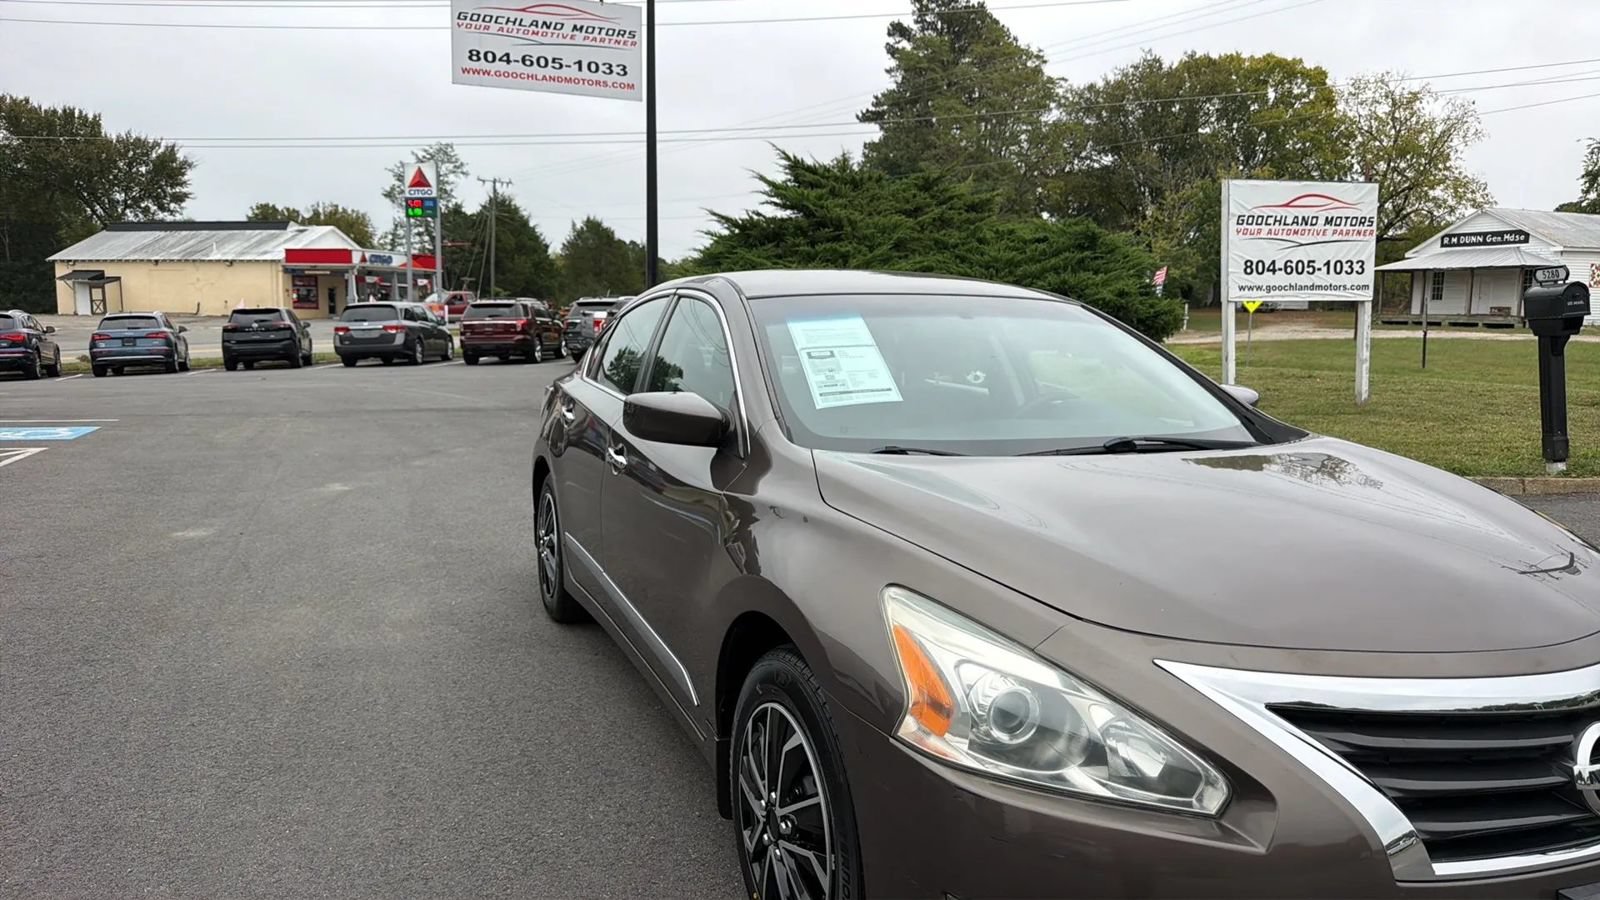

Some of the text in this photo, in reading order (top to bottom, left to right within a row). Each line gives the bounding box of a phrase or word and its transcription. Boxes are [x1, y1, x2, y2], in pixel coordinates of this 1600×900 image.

[456, 11, 637, 40] GOOCHLAND MOTORS
[456, 22, 638, 48] YOUR AUTOMOTIVE PARTNER
[467, 49, 628, 77] 804-605-1033
[461, 67, 635, 90] WWW.GOOCHLANDMOTORS.COM
[1236, 214, 1375, 228] GOOCHLAND MOTORS
[1266, 228, 1329, 236] AUTOMOTIVE
[1331, 229, 1375, 237] PARTNER
[1460, 235, 1484, 244] DUNN
[1243, 259, 1366, 276] 804-605-1033
[1542, 269, 1560, 279] 5280
[1238, 283, 1370, 293] www.goochlandmotors.com
